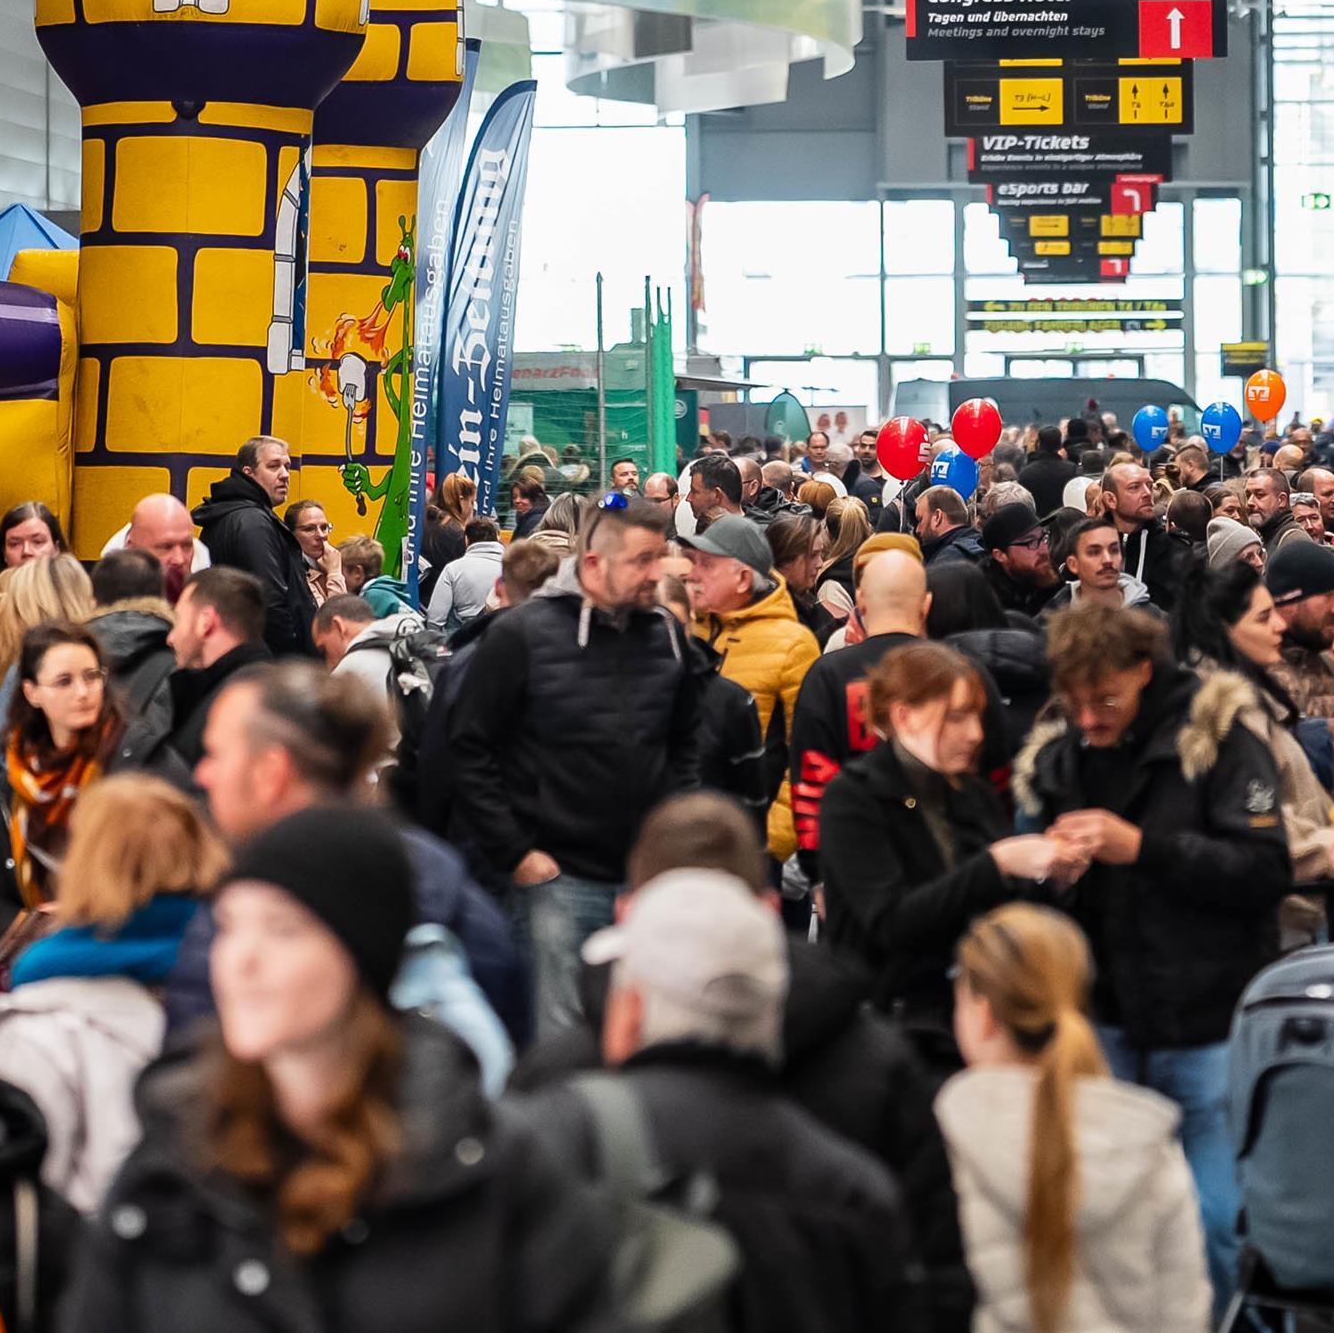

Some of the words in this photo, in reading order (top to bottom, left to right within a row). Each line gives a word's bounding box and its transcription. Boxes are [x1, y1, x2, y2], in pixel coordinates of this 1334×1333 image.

[928, 12, 964, 25] Tagen
[967, 12, 991, 22] und
[928, 26, 983, 40] Meetings
[986, 26, 1009, 37] and
[1012, 26, 1069, 39] overnight
[1072, 25, 1105, 38] stays
[982, 136, 1090, 151] VIP-Tickets
[998, 184, 1058, 197] eSports
[485, 432, 497, 473] Ihre
